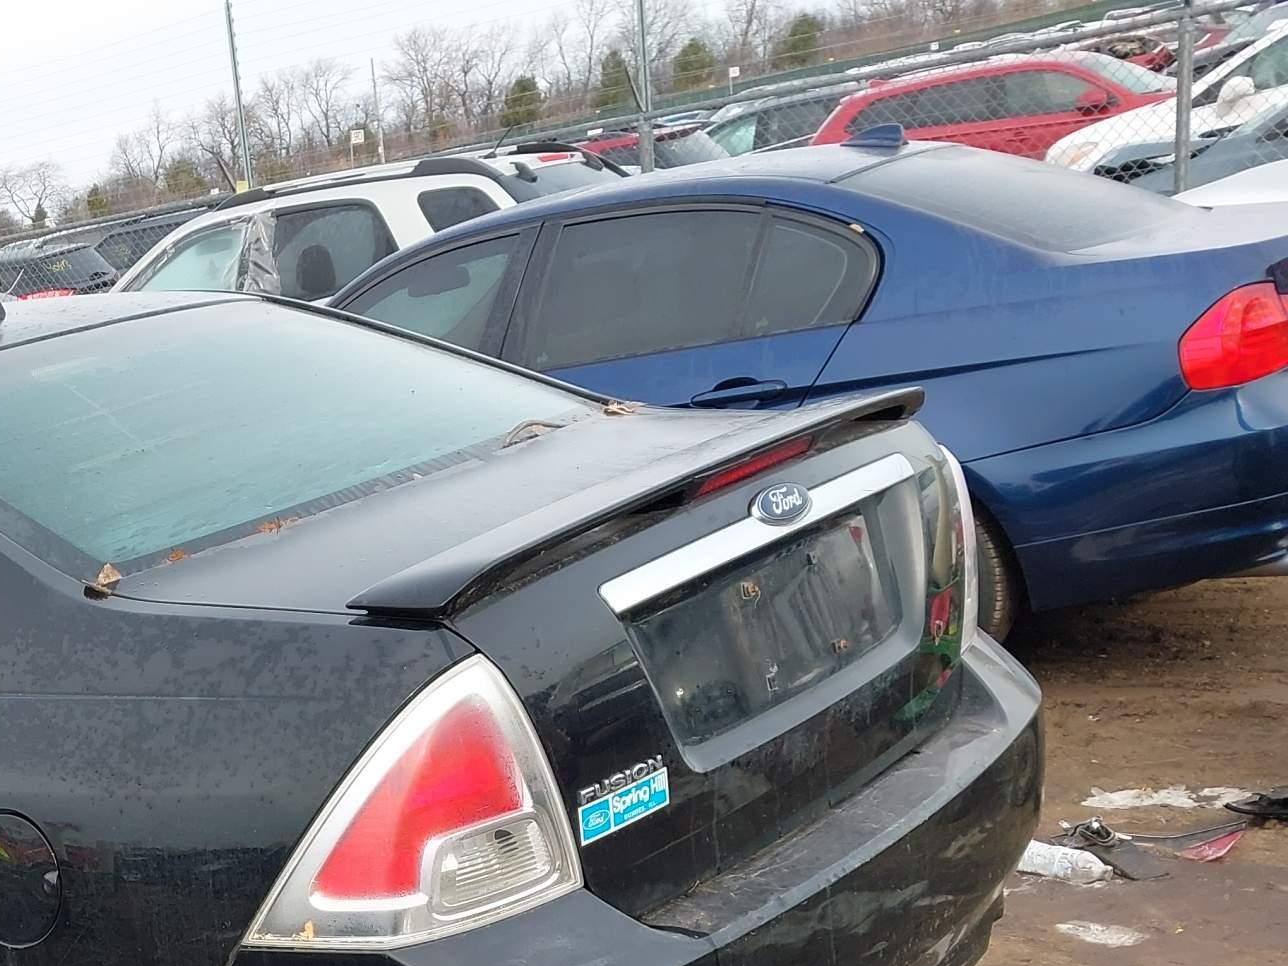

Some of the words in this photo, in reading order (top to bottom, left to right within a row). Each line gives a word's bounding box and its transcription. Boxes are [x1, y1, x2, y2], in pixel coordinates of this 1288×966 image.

[769, 486, 803, 515] Ford
[576, 754, 664, 805] FUSION
[612, 785, 650, 814] Spring
[650, 771, 666, 795] Hill
